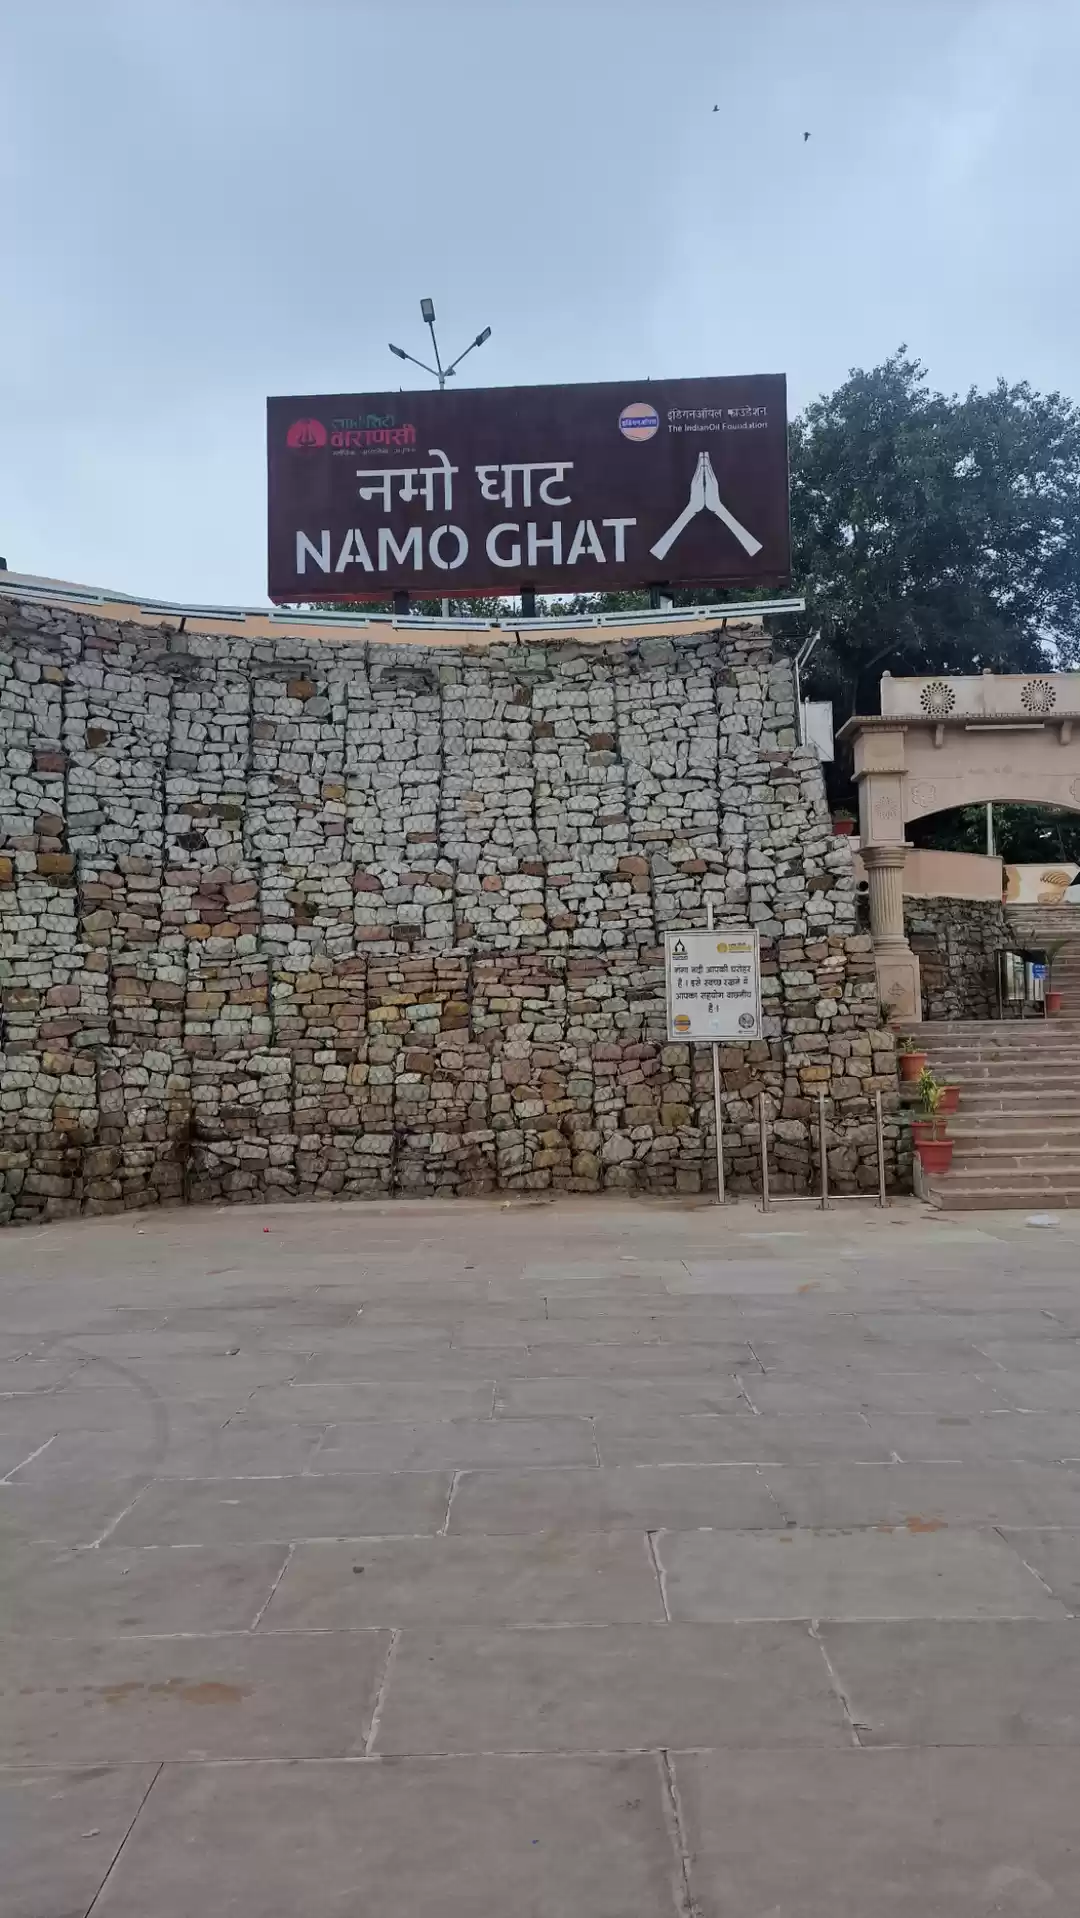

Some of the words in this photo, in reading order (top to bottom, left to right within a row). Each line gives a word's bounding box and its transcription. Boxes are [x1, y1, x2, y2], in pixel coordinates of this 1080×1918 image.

[331, 423, 417, 448] वाराणसी
[667, 424, 683, 433] The
[684, 423, 720, 432] IndianOil
[722, 421, 768, 431] Foundation
[356, 448, 459, 513] नमो
[475, 461, 574, 509] घाट
[296, 524, 469, 574] NAMO
[485, 517, 637, 568] GHAT
